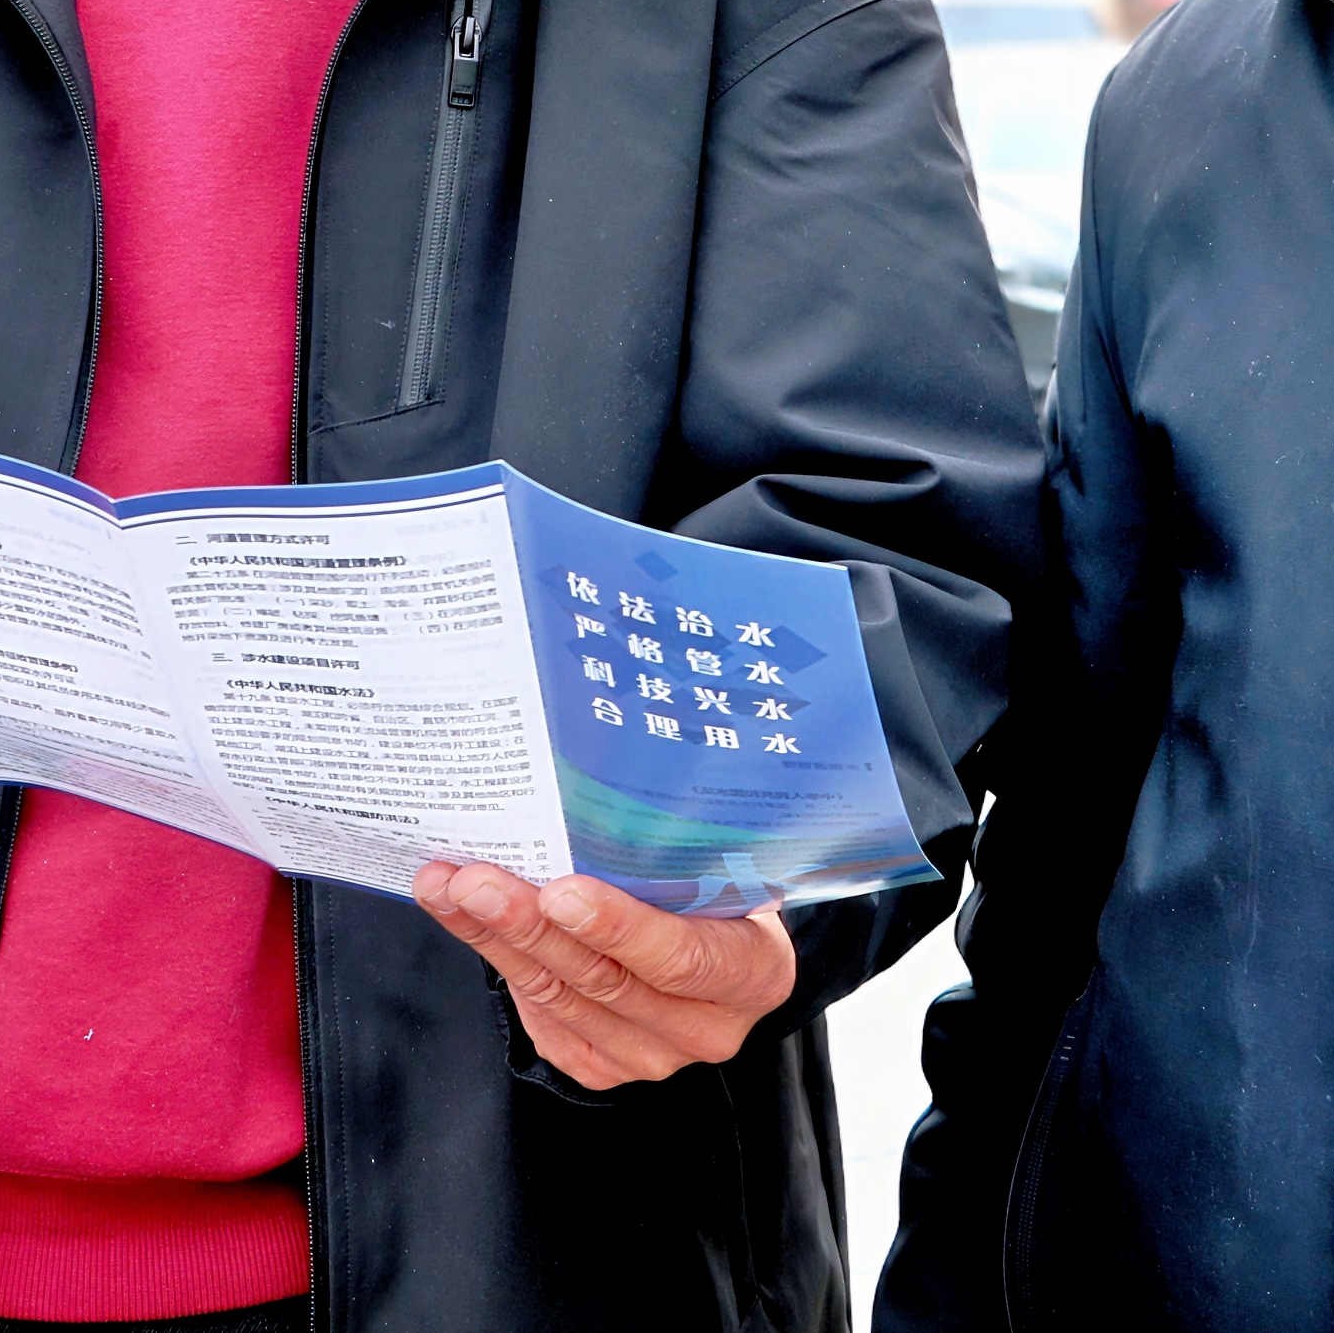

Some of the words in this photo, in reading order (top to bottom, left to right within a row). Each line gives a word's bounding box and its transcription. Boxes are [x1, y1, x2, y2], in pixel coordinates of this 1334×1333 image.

[567, 570, 776, 648] 依法治水
[574, 612, 784, 686] 严格管水
[582, 653, 793, 721] 科技兴水
[591, 697, 802, 755] 合理用水
